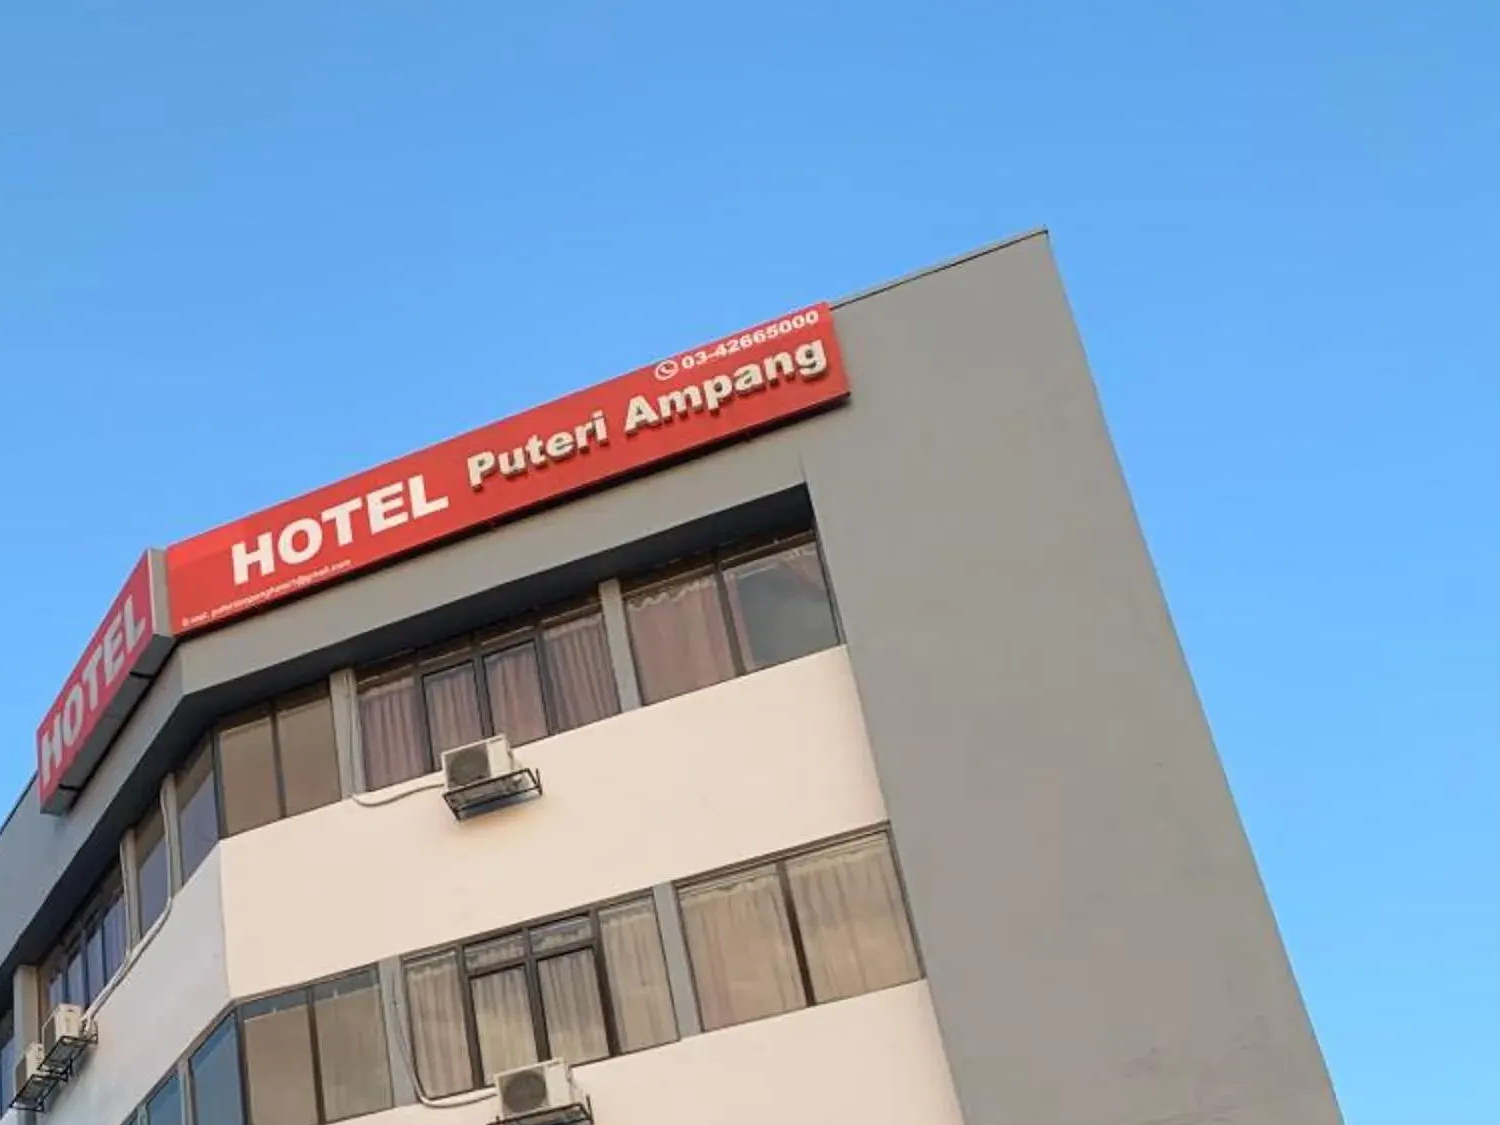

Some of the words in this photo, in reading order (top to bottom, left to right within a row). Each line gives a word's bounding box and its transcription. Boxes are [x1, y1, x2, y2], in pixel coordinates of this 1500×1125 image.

[230, 474, 449, 586] HOTEL
[466, 410, 608, 488] Puteri
[624, 339, 828, 433] Ampang
[41, 594, 147, 783] HOTEL
